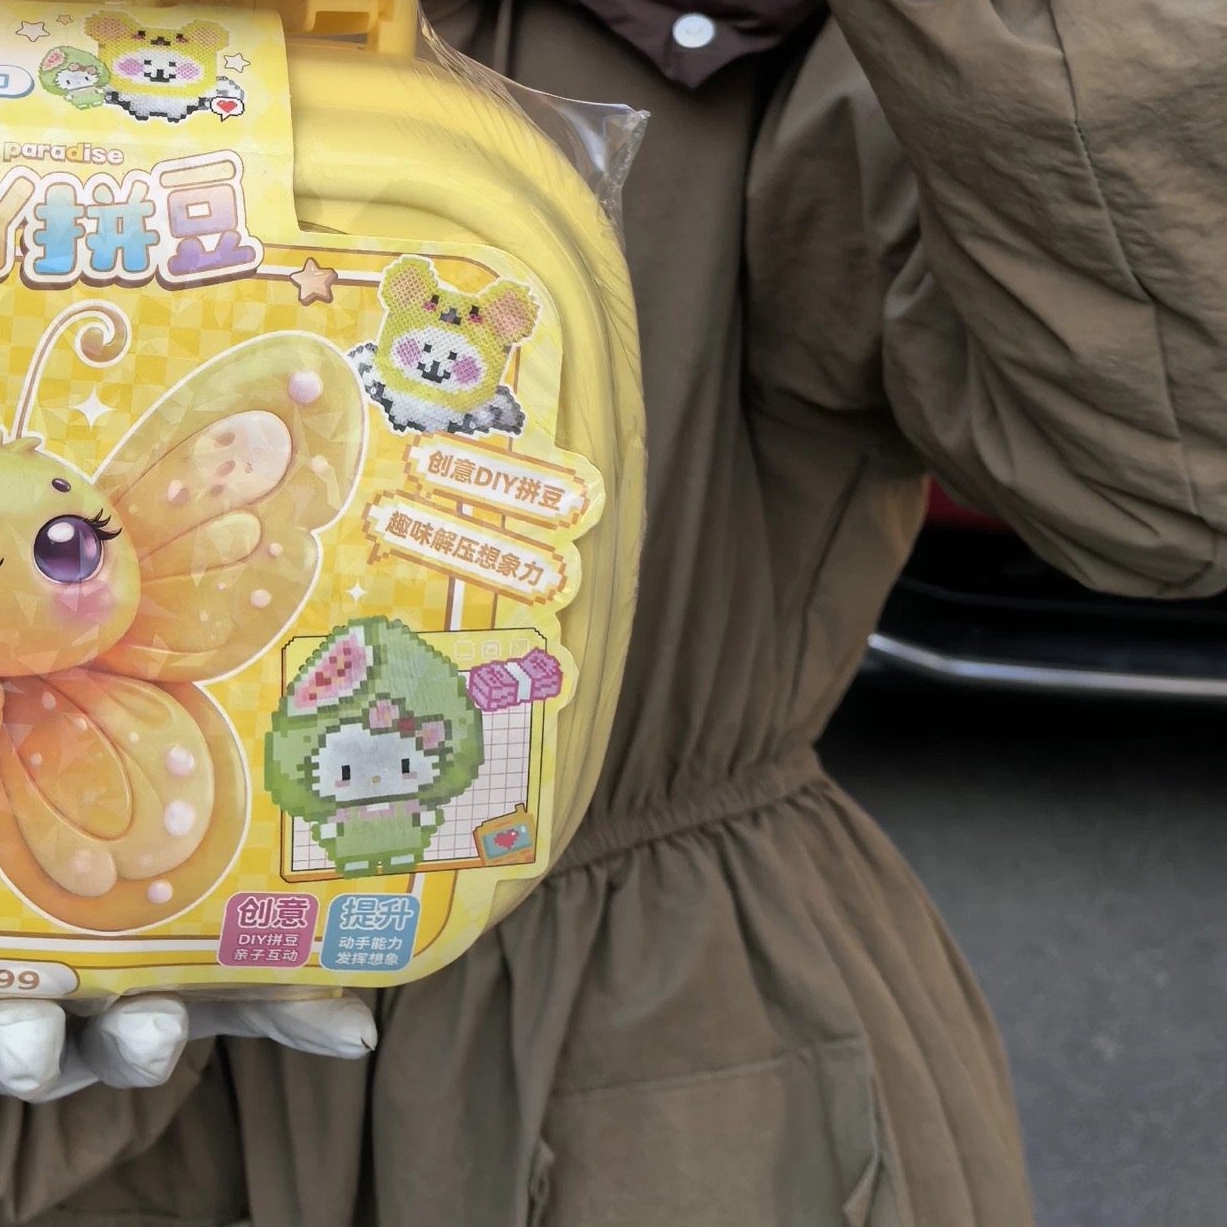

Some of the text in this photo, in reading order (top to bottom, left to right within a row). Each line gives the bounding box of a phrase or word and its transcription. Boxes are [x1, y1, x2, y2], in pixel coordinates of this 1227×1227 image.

[3, 142, 125, 165] paradise
[428, 450, 565, 511] 创意DIY拼豆
[385, 511, 544, 586] 趣味解压想象力
[237, 896, 311, 929] 创意
[339, 896, 415, 931] 提升
[238, 933, 300, 947] DIY拼豆
[338, 936, 403, 951] 动手能力
[233, 948, 299, 962] 亲子互动
[335, 952, 399, 967] 发挥想象
